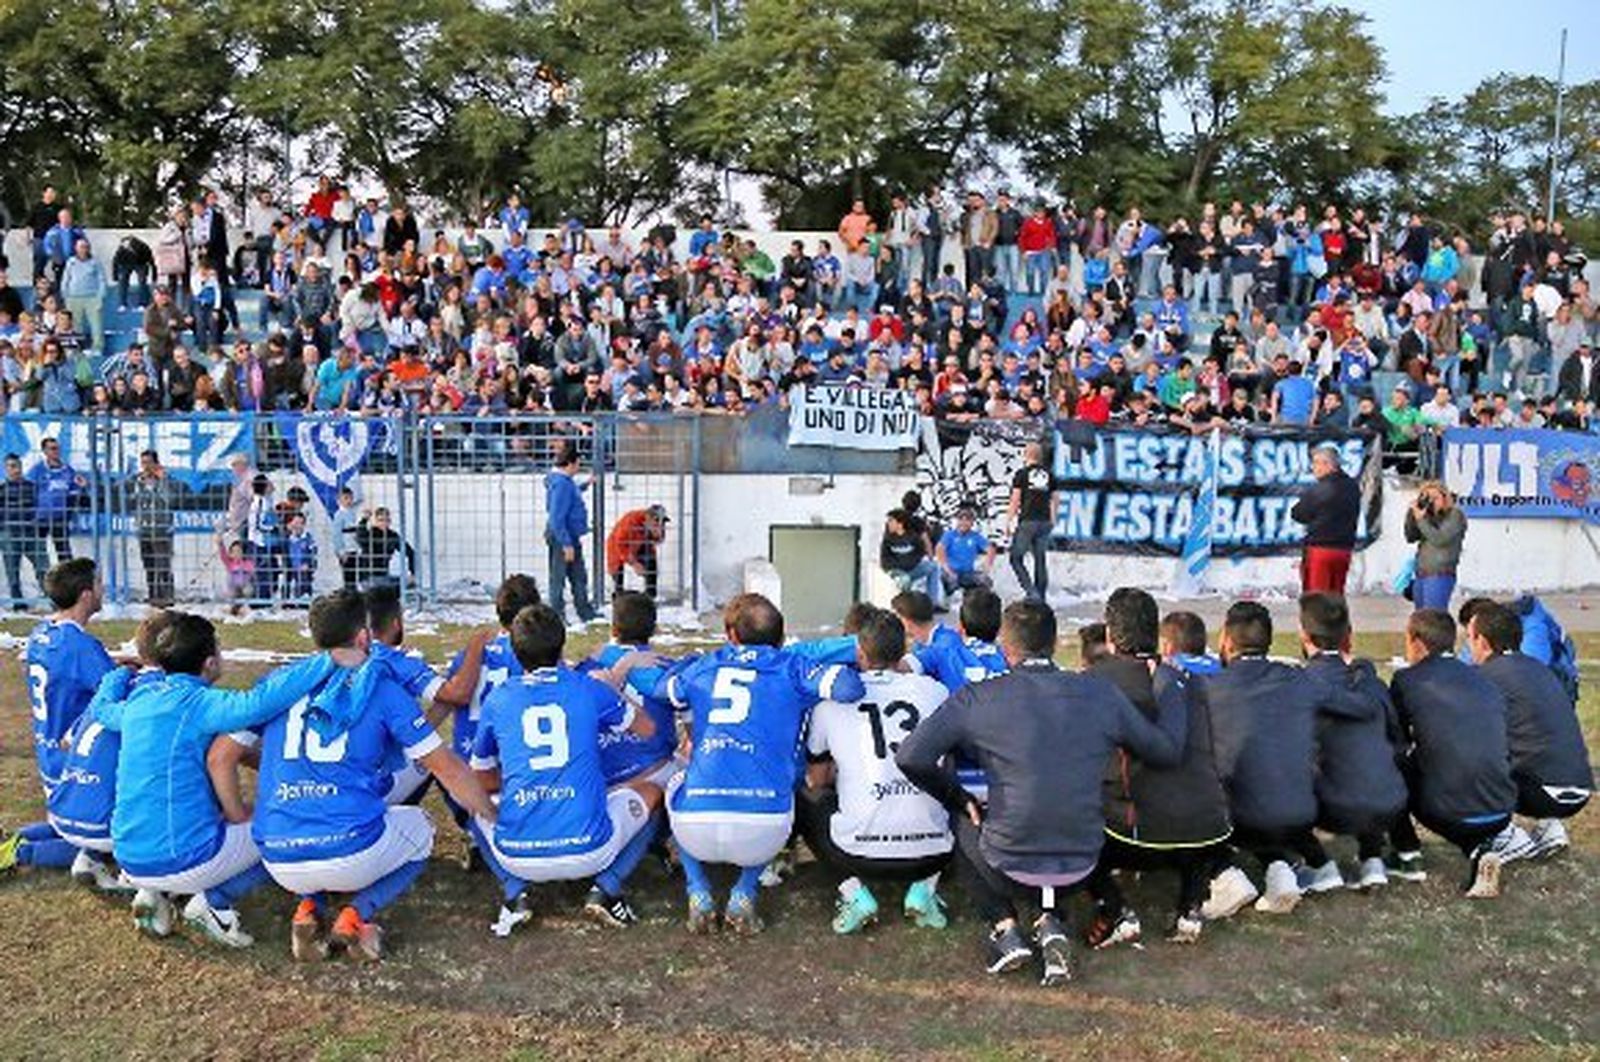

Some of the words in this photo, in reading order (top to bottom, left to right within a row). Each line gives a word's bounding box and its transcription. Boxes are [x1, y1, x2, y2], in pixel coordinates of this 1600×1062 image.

[805, 407, 845, 431] UNO
[854, 410, 876, 434] DI
[1115, 433, 1246, 486] ESTAS
[1210, 497, 1368, 544] BATA
[708, 667, 757, 724] 5
[521, 703, 569, 770] 9
[858, 700, 920, 759] 13
